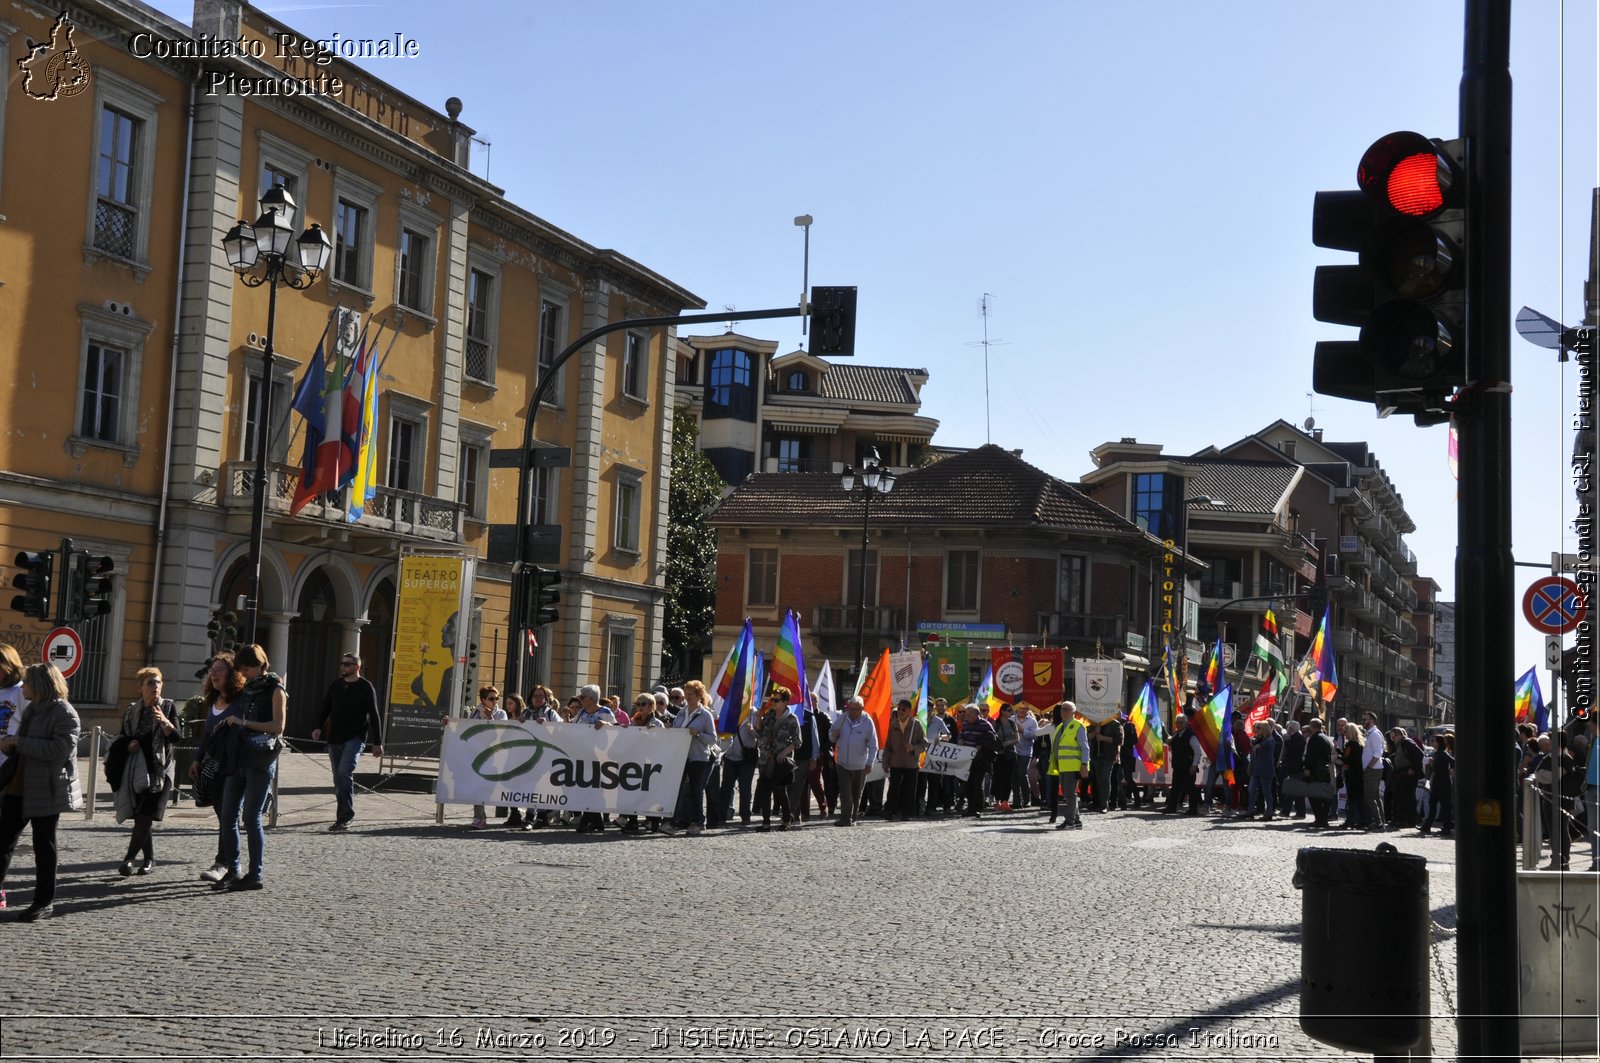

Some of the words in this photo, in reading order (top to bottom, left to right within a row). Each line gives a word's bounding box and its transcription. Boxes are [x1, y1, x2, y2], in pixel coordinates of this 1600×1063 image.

[406, 568, 458, 581] TEATRO
[404, 579, 457, 590] SUPERGA
[920, 622, 967, 630] ORTOPEDIA
[550, 757, 663, 791] auser
[501, 791, 568, 806] NICHELINO
